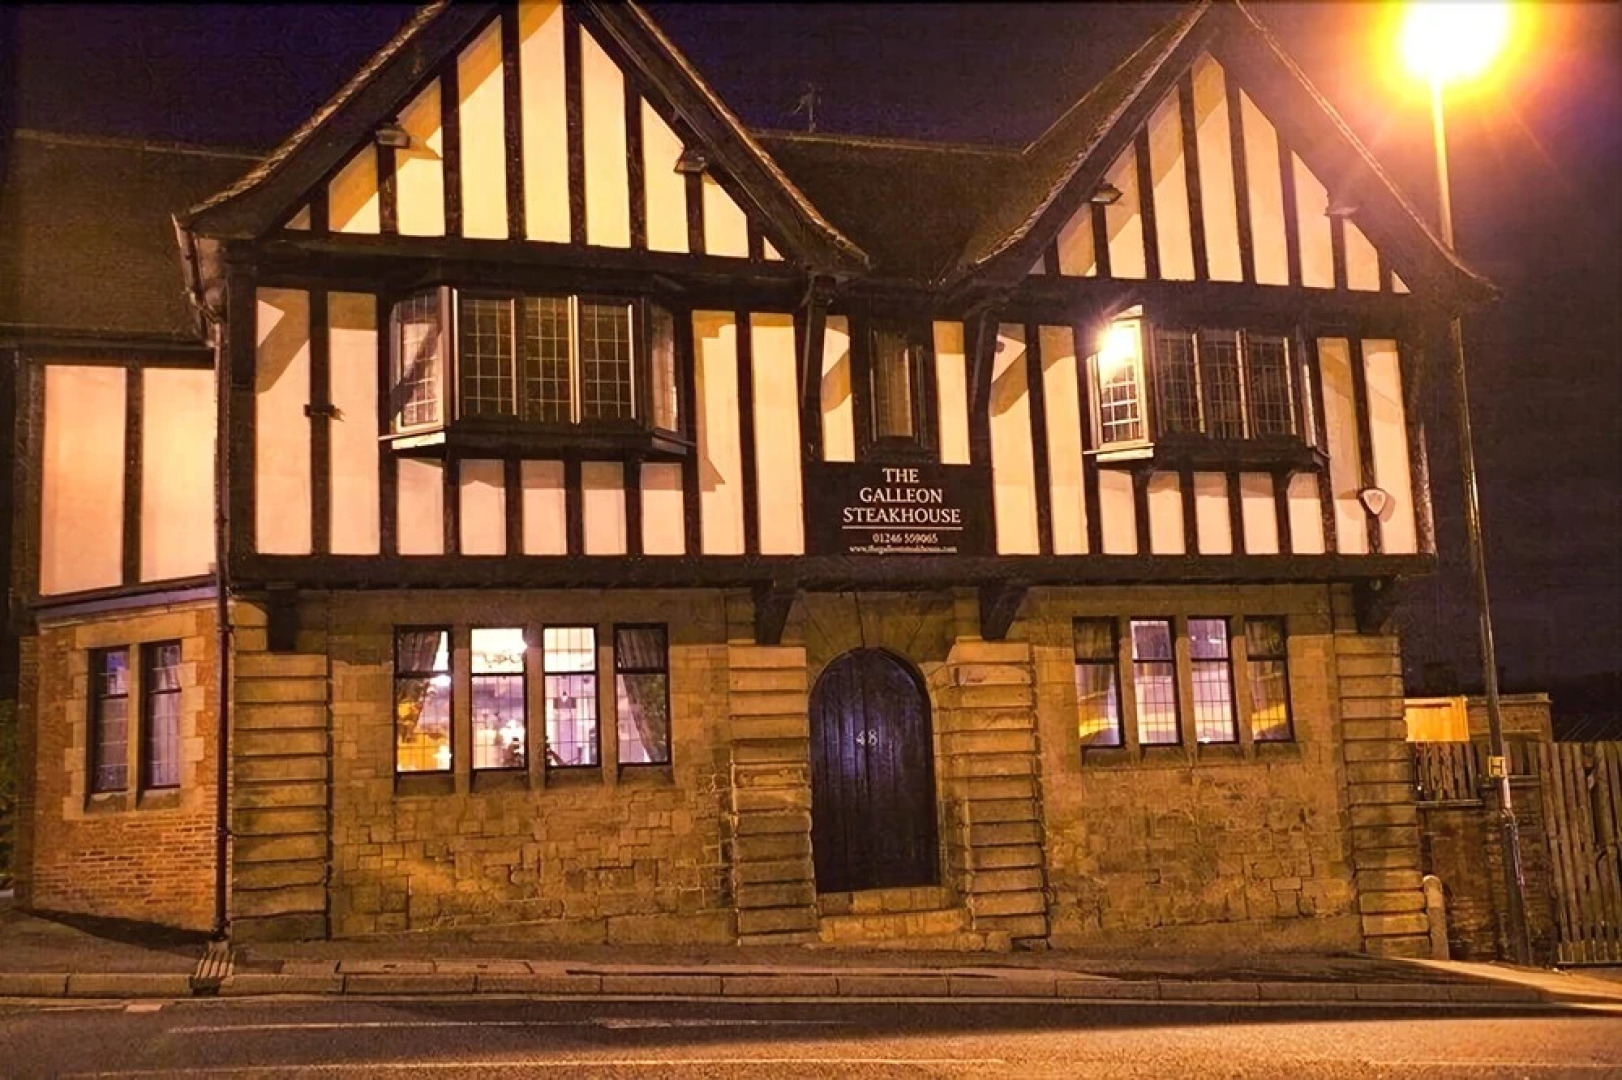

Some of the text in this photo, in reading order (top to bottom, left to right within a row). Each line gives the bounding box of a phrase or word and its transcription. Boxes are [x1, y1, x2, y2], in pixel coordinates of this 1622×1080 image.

[882, 468, 919, 483] THE
[860, 487, 943, 503] GALLEON
[843, 507, 961, 522] STEAKHOUSE
[872, 532, 903, 544] 01246
[856, 729, 877, 746] 48
[1490, 758, 1503, 776] H
